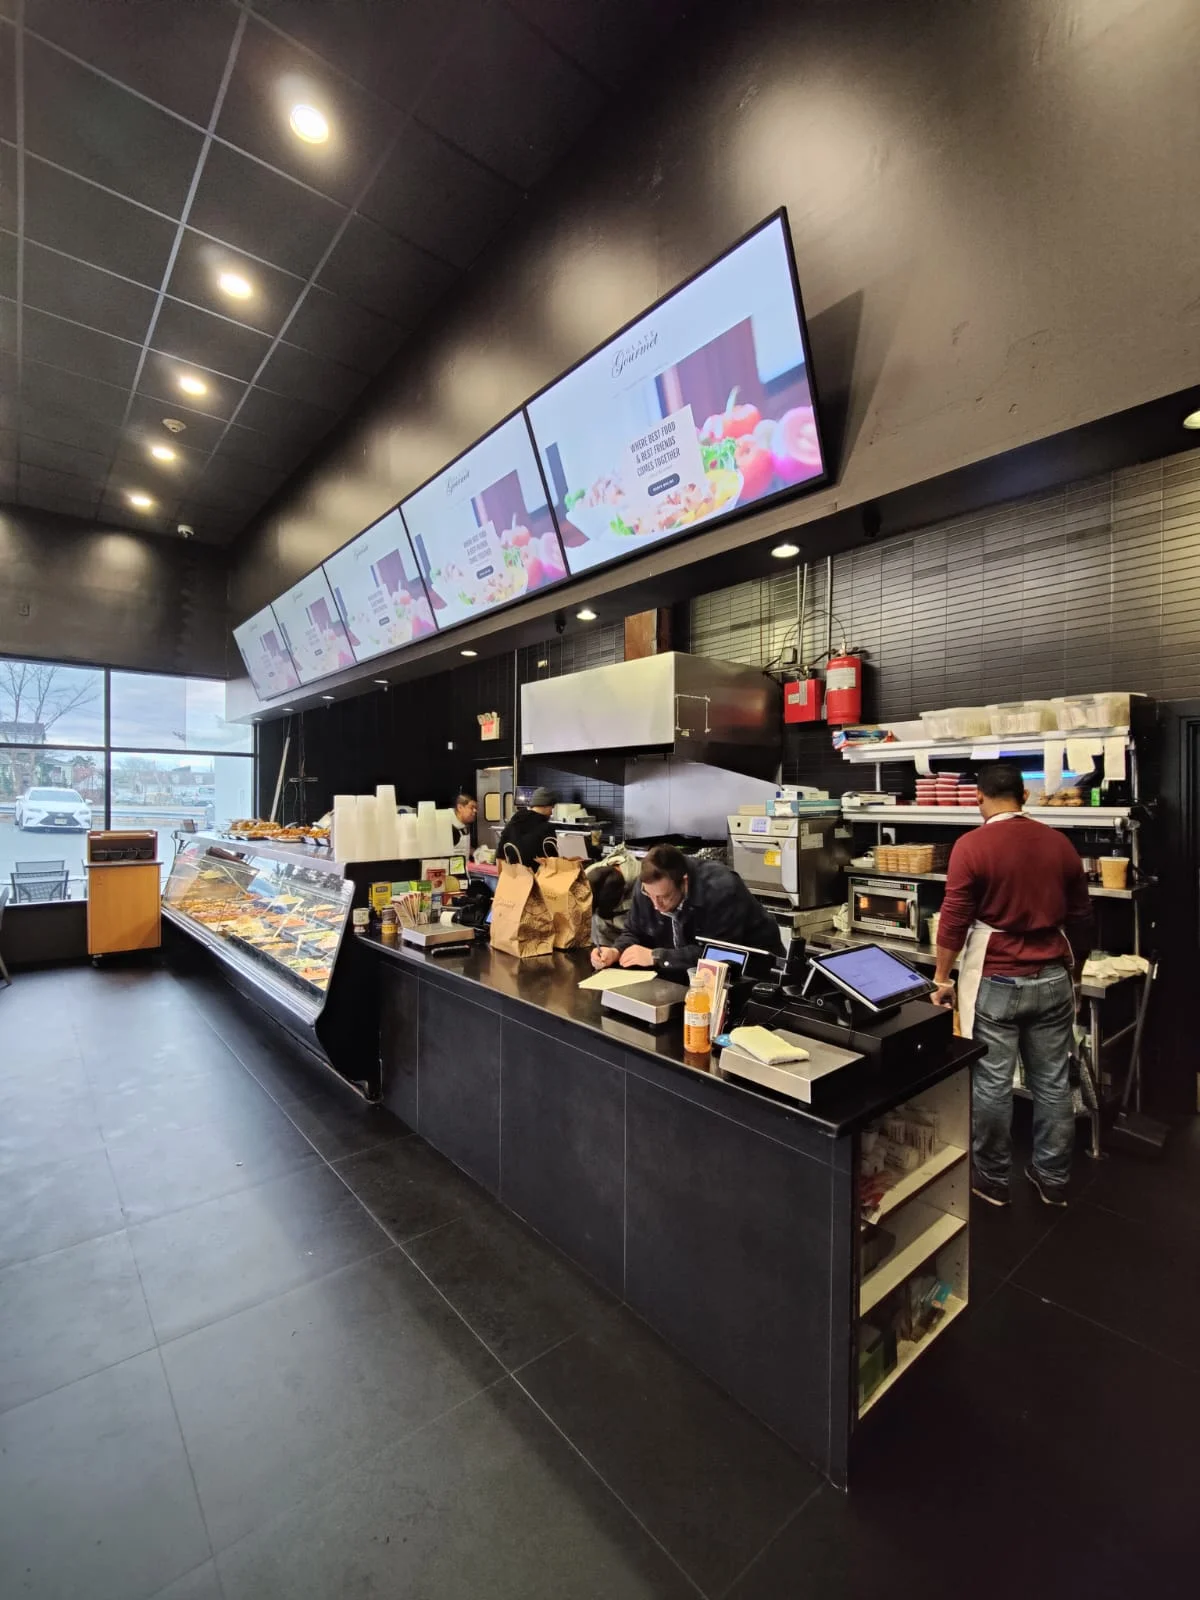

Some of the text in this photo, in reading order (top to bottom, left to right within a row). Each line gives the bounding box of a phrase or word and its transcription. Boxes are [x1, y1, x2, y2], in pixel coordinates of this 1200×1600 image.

[611, 332, 658, 378] Gourmet
[630, 421, 676, 453] WHERE BEST FOOD
[641, 447, 653, 462] BEST
[654, 436, 676, 454] FRIENDS
[637, 461, 655, 477] COMES
[655, 447, 681, 468] TOGETHER
